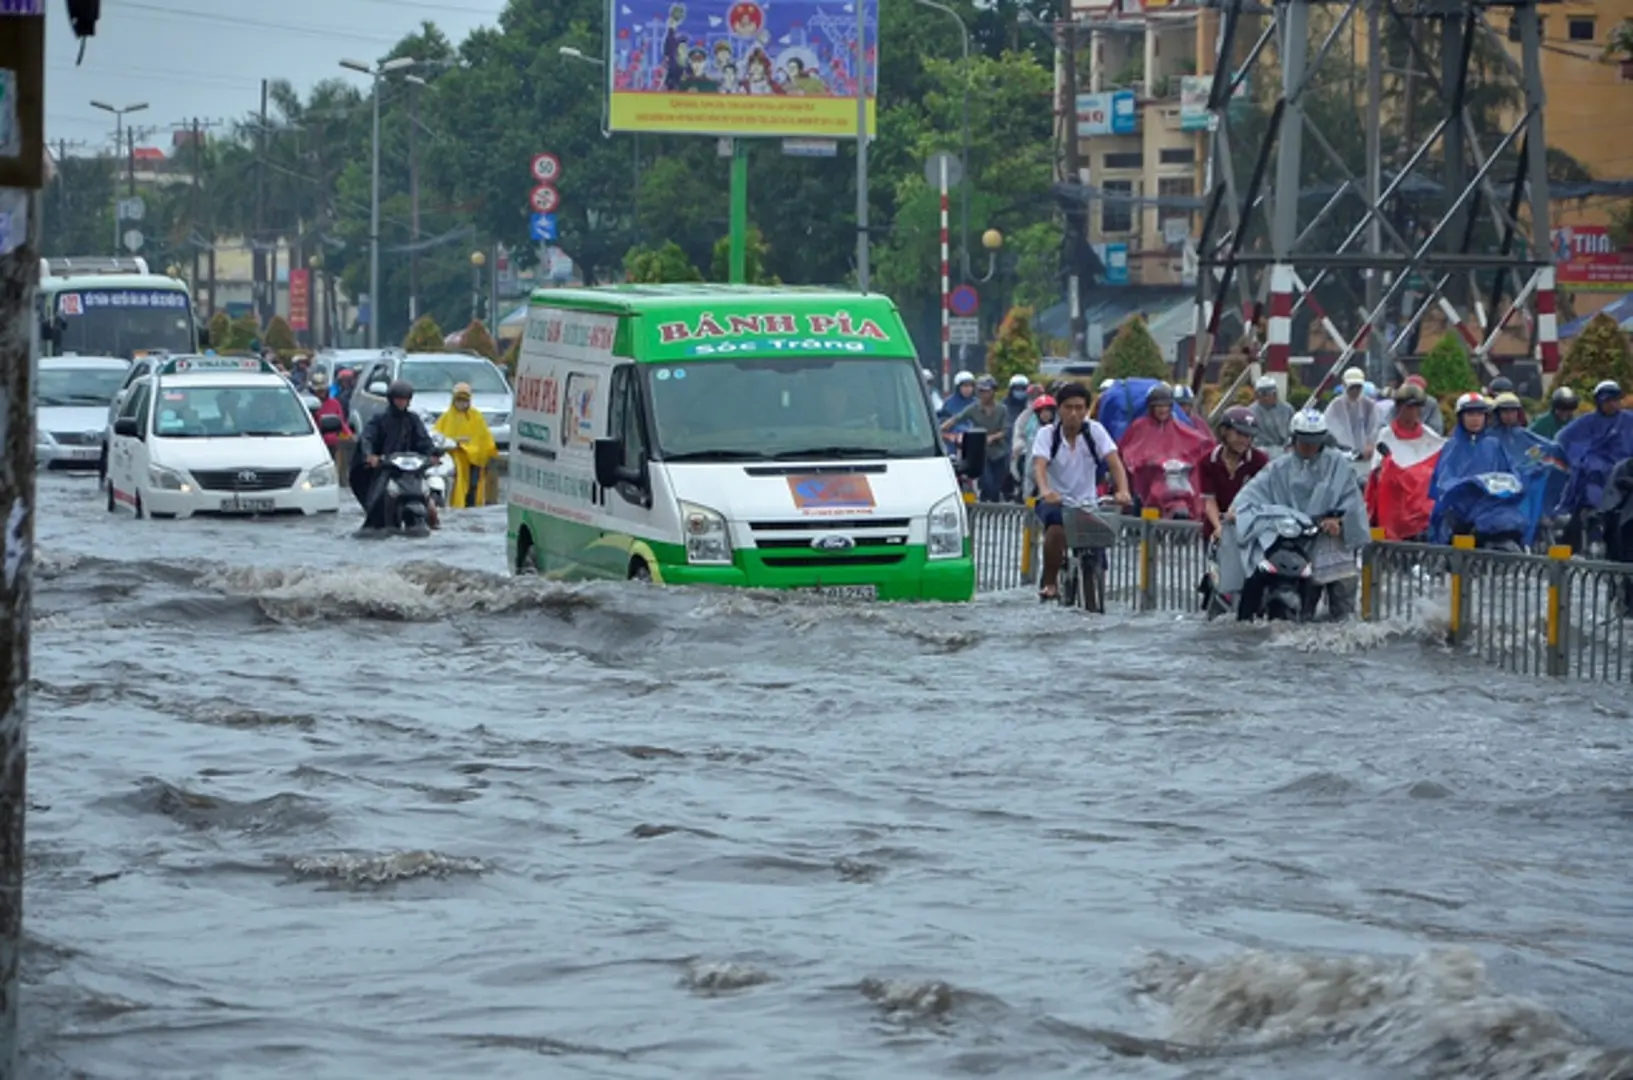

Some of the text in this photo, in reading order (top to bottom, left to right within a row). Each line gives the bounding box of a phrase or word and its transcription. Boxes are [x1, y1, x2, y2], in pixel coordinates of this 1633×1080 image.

[539, 160, 553, 174] 50
[658, 309, 890, 343] BÁNH PÍA
[695, 340, 757, 355] Sóc
[823, 535, 847, 549] Ford
